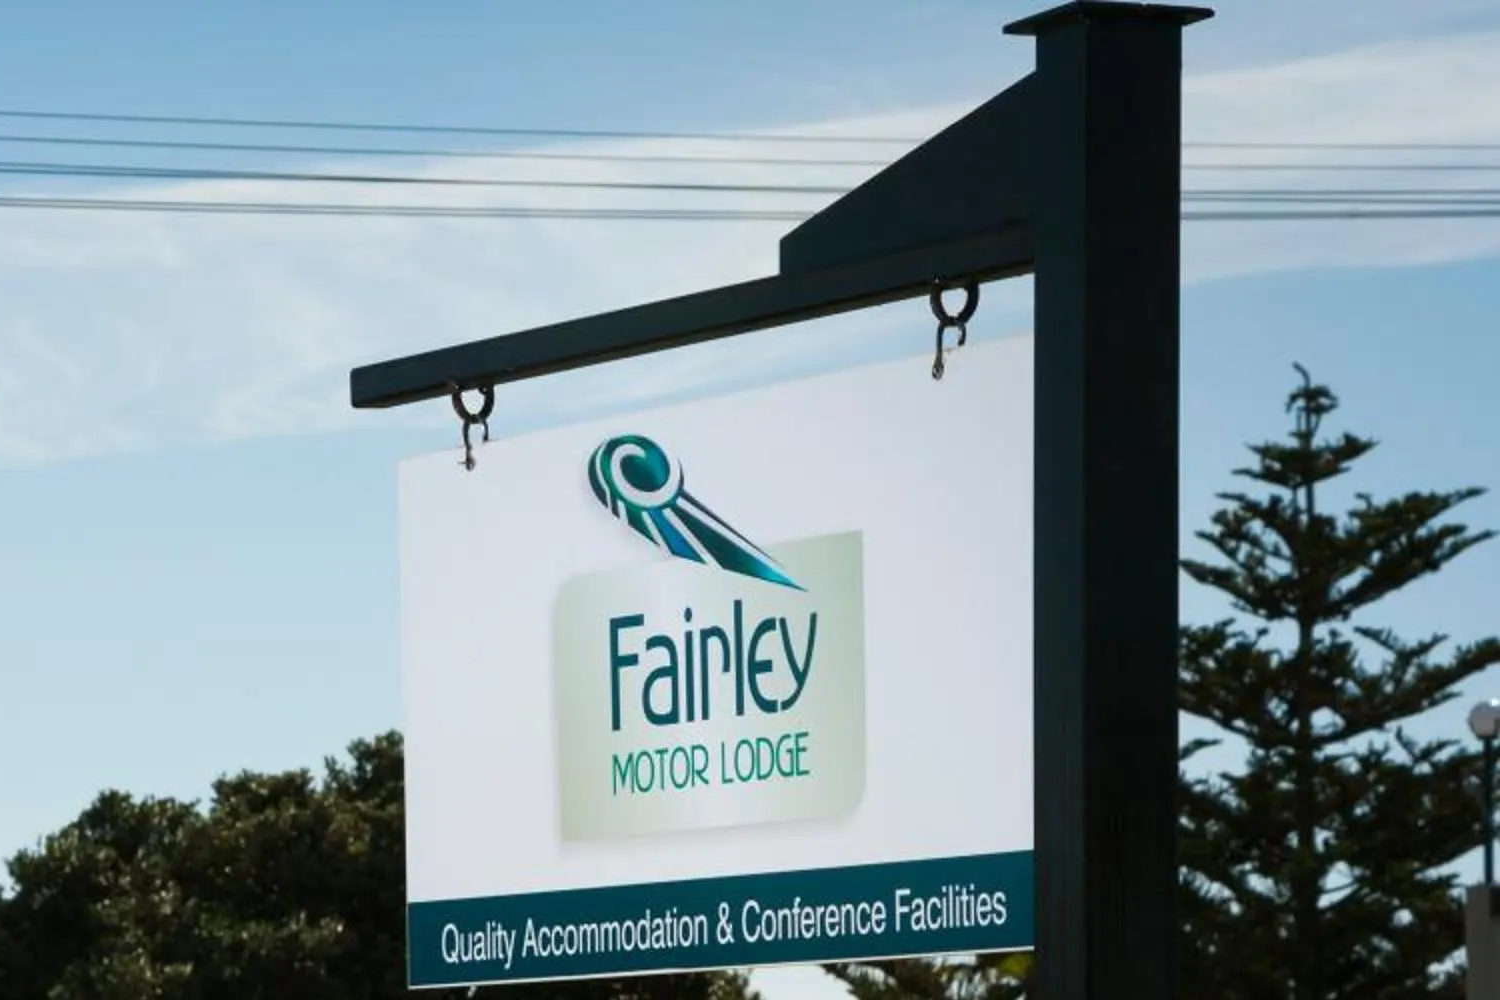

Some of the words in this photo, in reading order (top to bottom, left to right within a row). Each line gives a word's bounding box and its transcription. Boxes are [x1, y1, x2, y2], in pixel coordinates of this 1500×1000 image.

[609, 599, 817, 731] Fairley
[612, 744, 709, 795] MOTOR
[721, 732, 810, 785] LODGE
[441, 921, 516, 970] Quality
[521, 907, 708, 958] Accommodation
[716, 901, 734, 945] &
[741, 897, 886, 943] Conference
[895, 883, 1007, 932] Facilities
